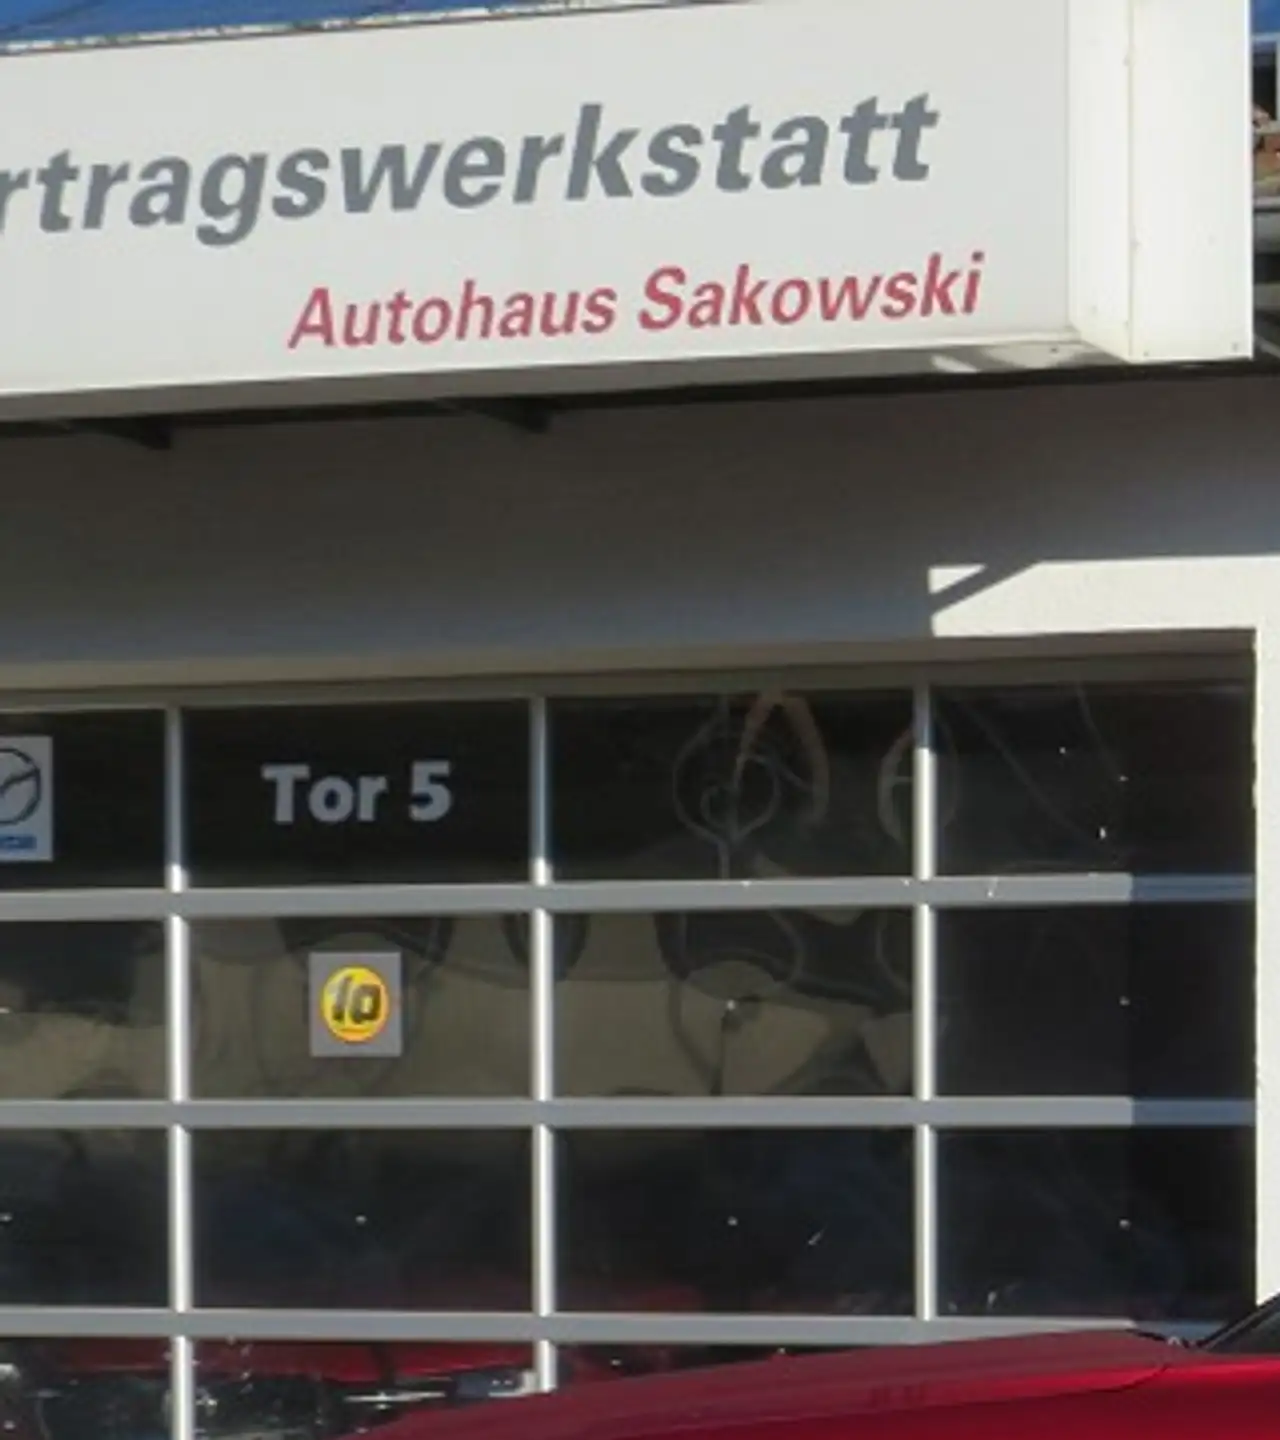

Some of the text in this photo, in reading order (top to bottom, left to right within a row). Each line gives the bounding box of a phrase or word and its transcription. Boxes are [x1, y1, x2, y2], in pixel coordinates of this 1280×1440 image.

[287, 251, 986, 349] Autohaus Sakowski
[260, 759, 453, 825] Tor 5
